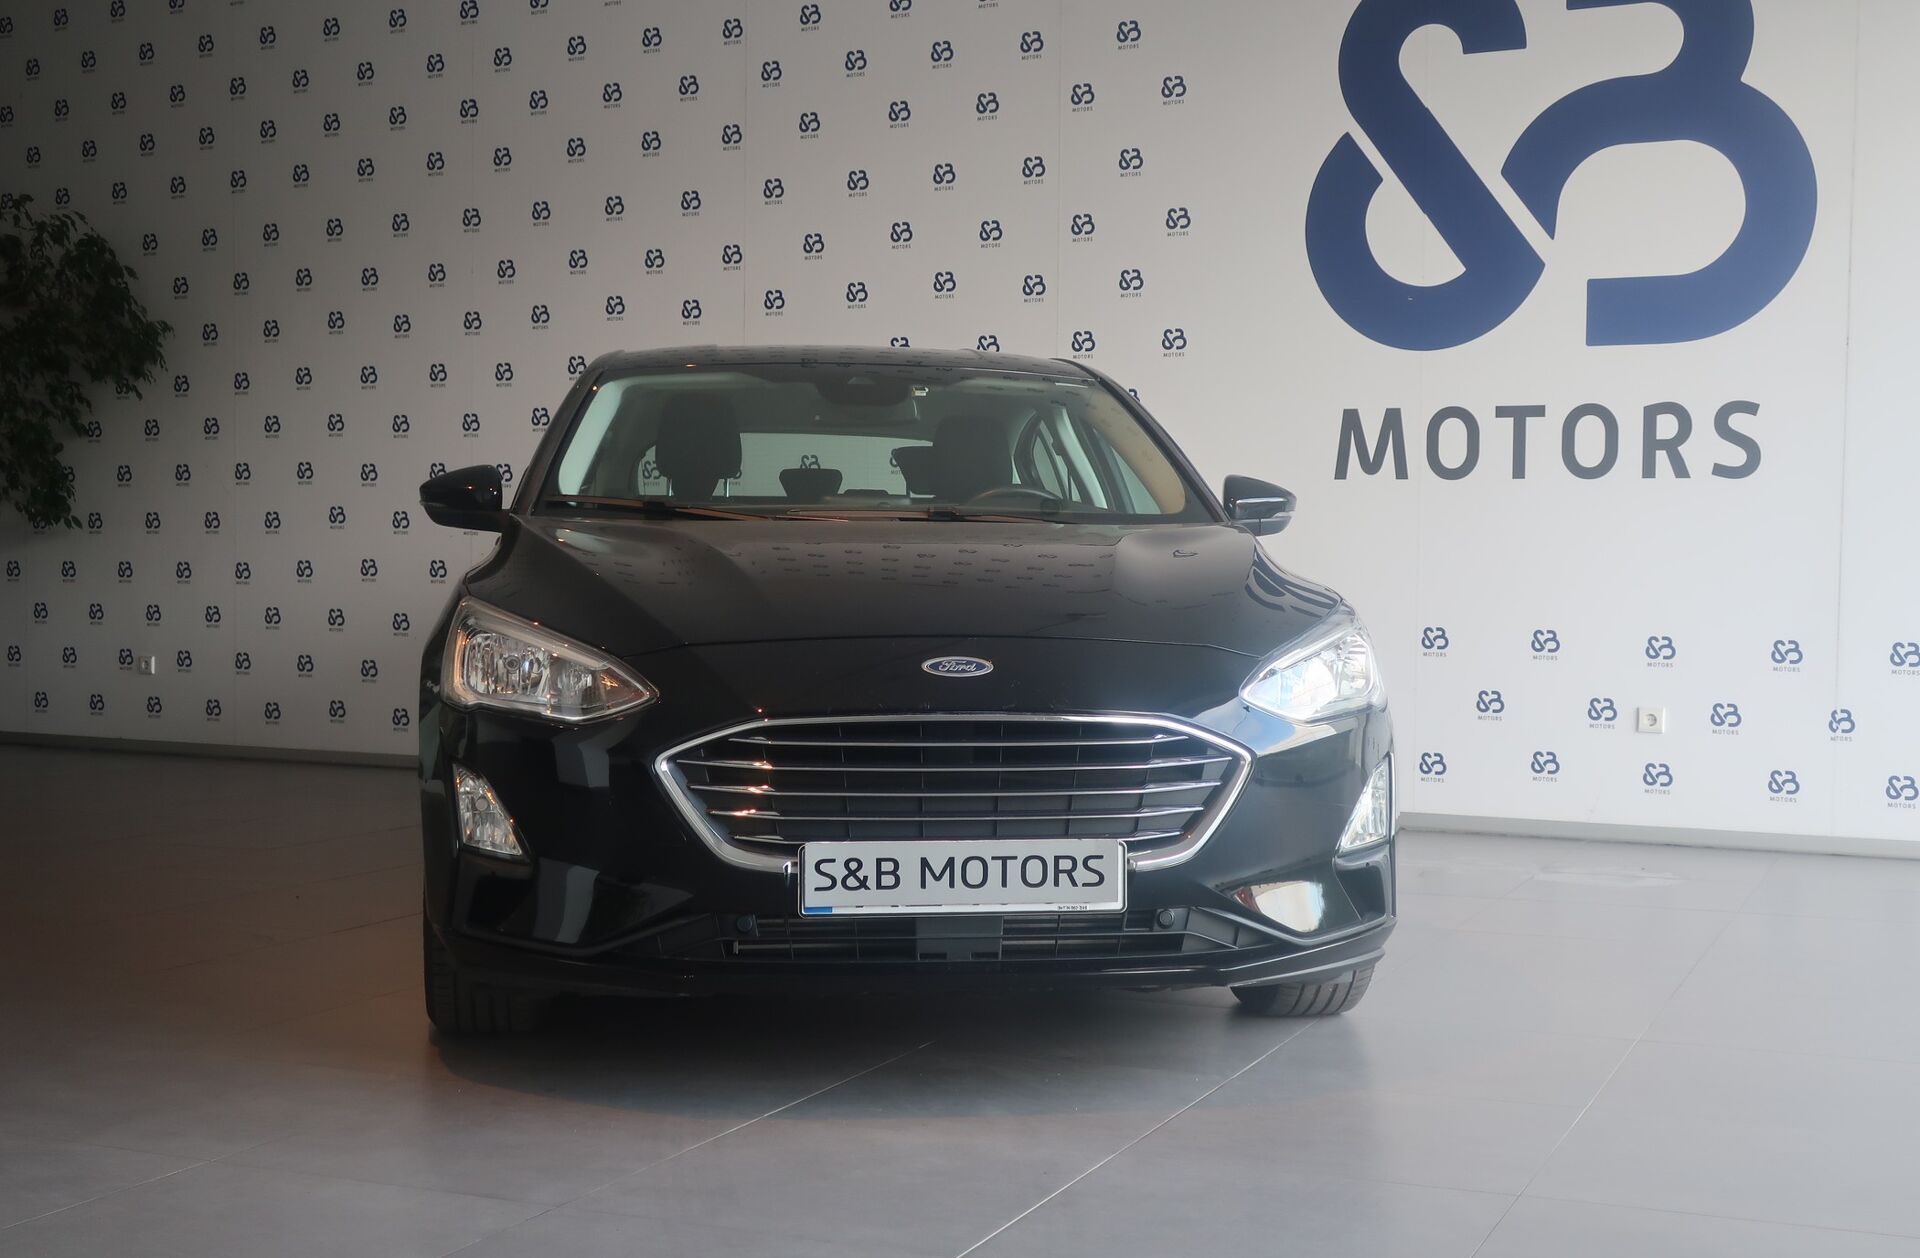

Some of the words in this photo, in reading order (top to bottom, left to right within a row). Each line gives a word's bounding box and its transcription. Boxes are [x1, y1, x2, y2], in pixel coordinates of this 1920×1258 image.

[1334, 400, 1762, 480] MOTORS
[938, 660, 977, 672] Ford
[813, 857, 901, 892] S&B
[920, 855, 1105, 889] MOTORS
